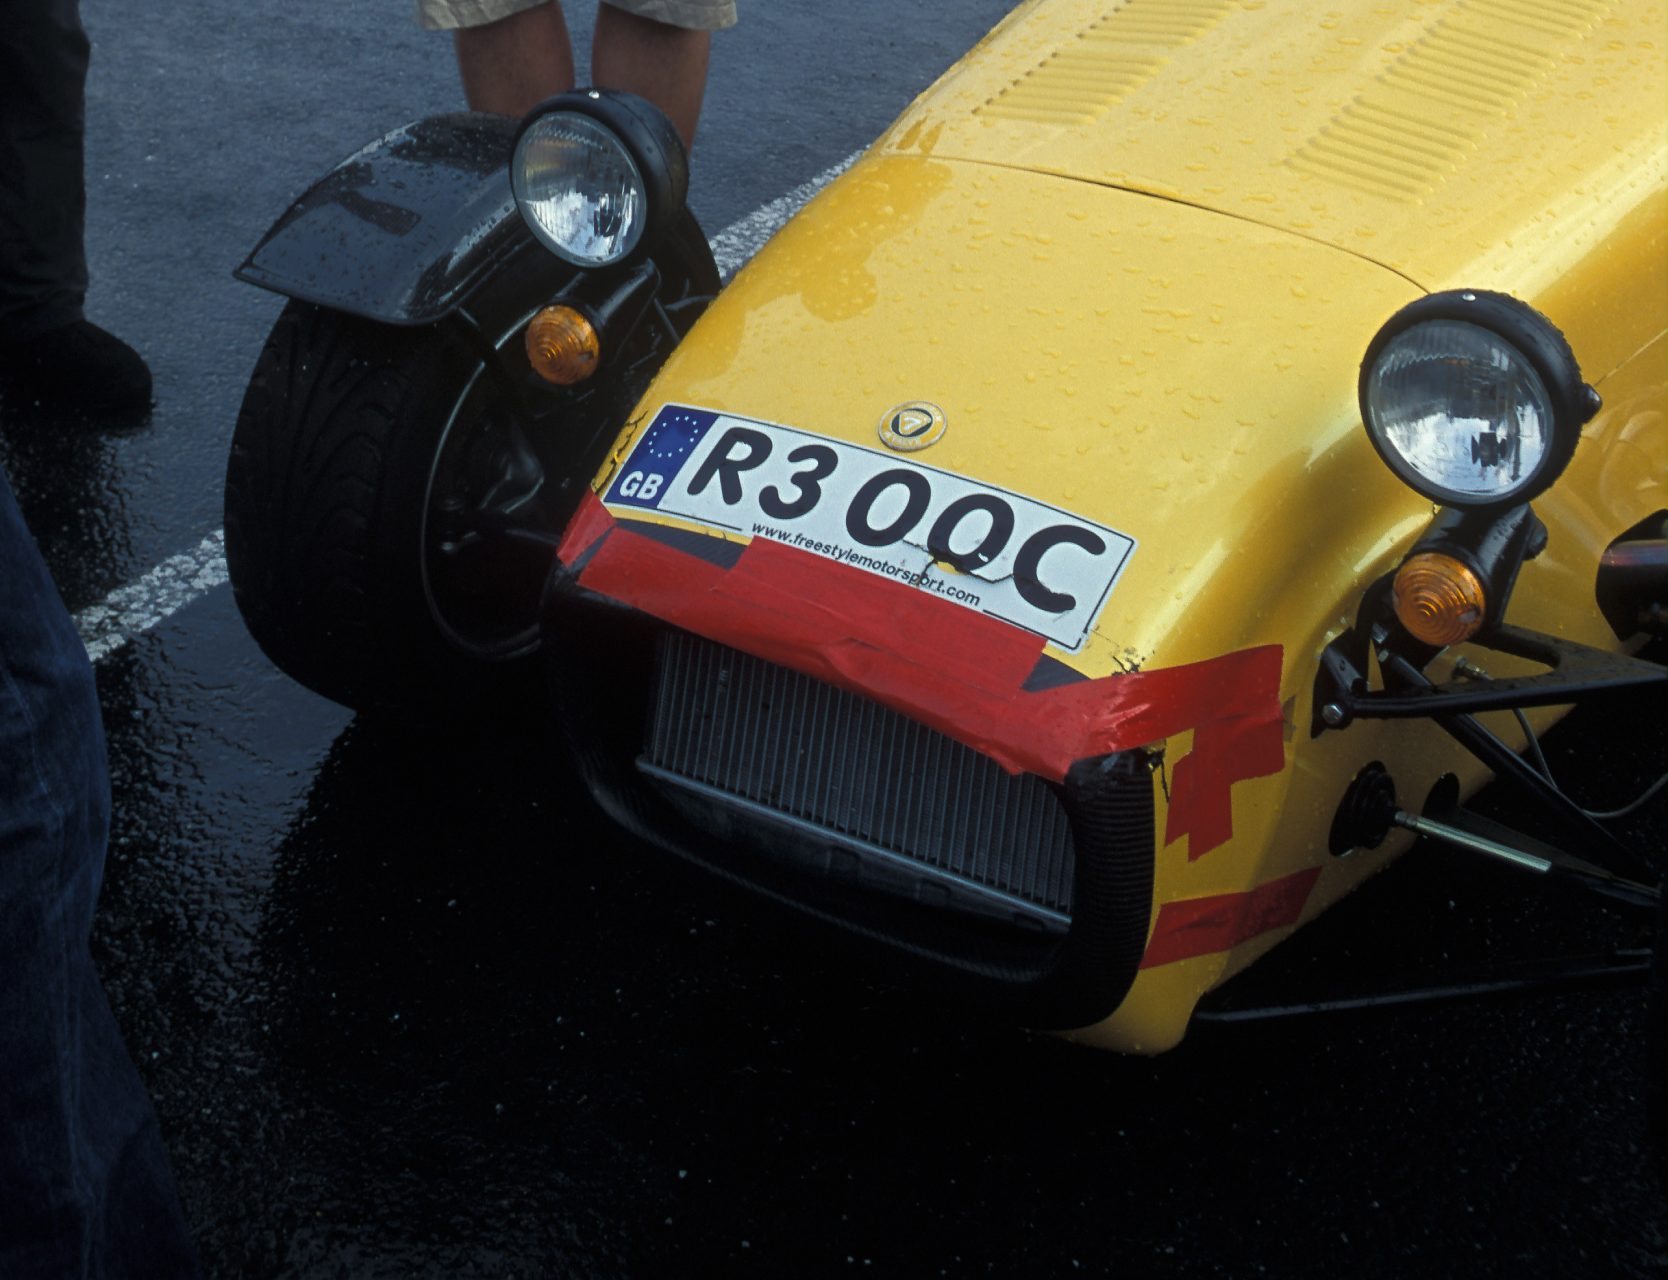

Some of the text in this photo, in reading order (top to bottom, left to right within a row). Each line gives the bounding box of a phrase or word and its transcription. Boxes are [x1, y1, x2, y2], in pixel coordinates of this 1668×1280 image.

[618, 470, 664, 500] GB
[686, 425, 839, 520] R3
[751, 522, 981, 607] www.freestylemotorsport.com
